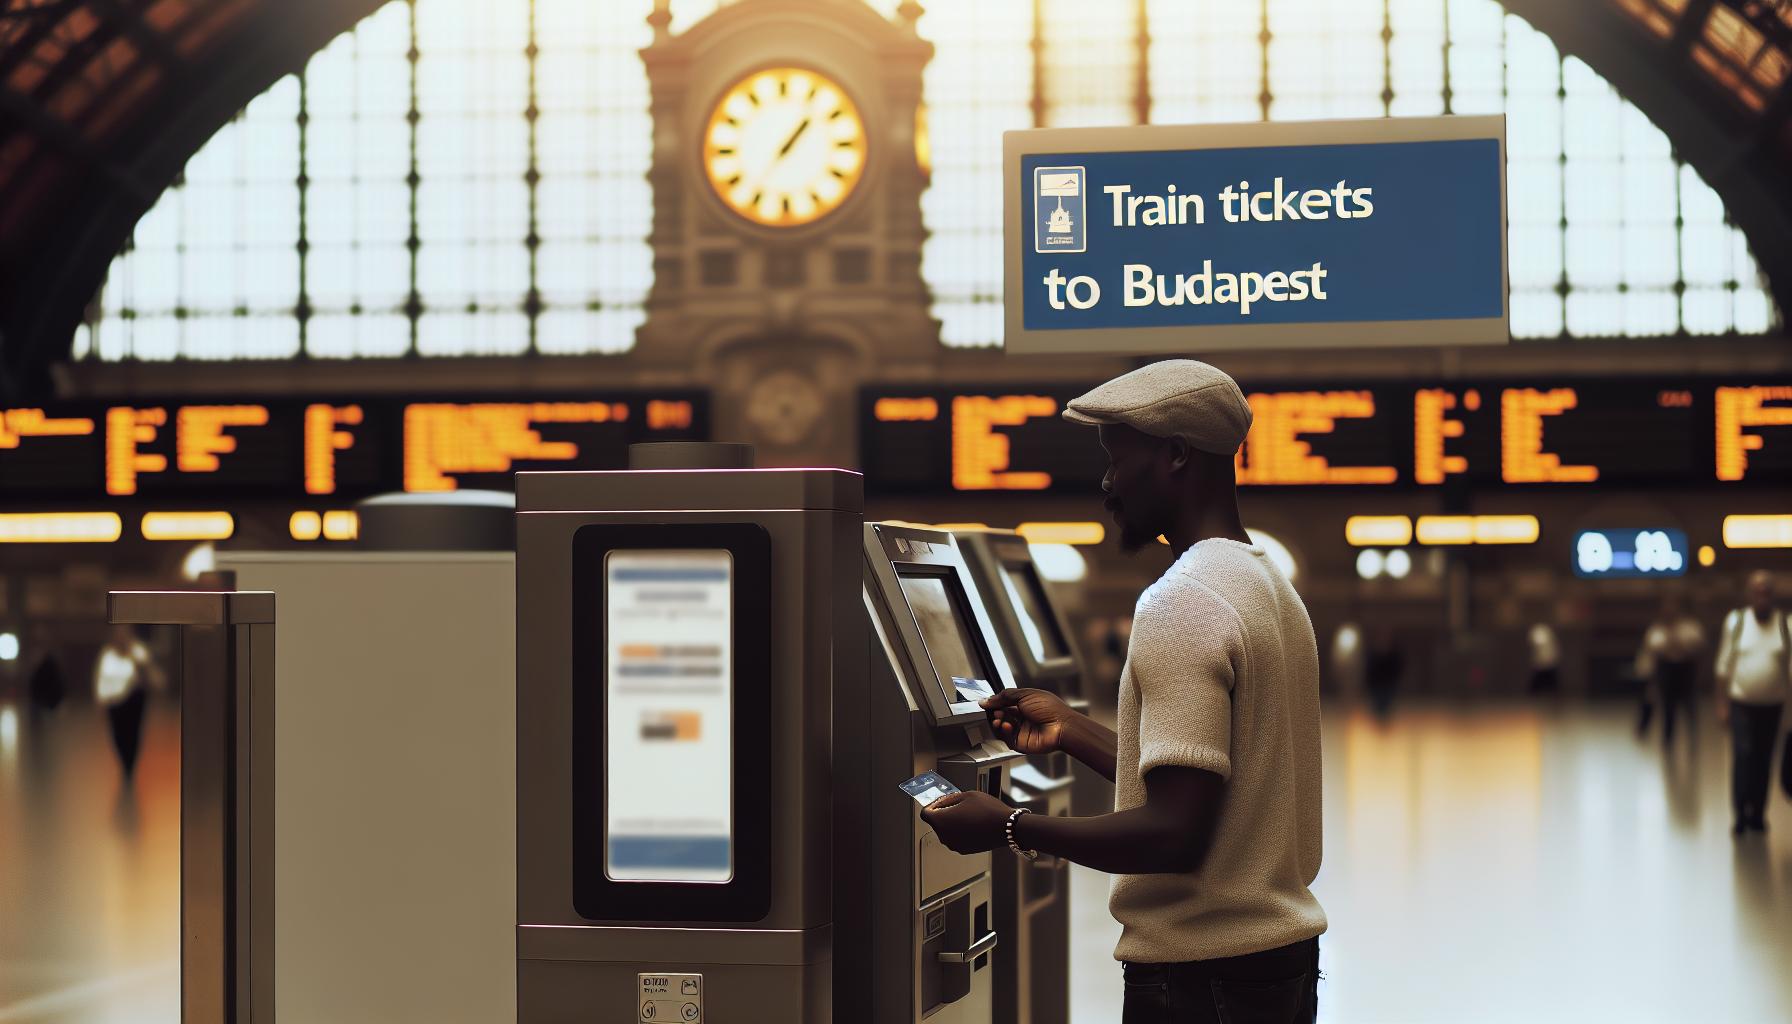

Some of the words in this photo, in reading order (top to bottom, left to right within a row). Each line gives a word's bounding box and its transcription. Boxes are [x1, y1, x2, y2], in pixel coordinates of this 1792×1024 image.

[1103, 184, 1205, 227] Train
[1218, 176, 1374, 223] tickets
[1043, 268, 1101, 310] to
[1123, 259, 1328, 315] Budapest
